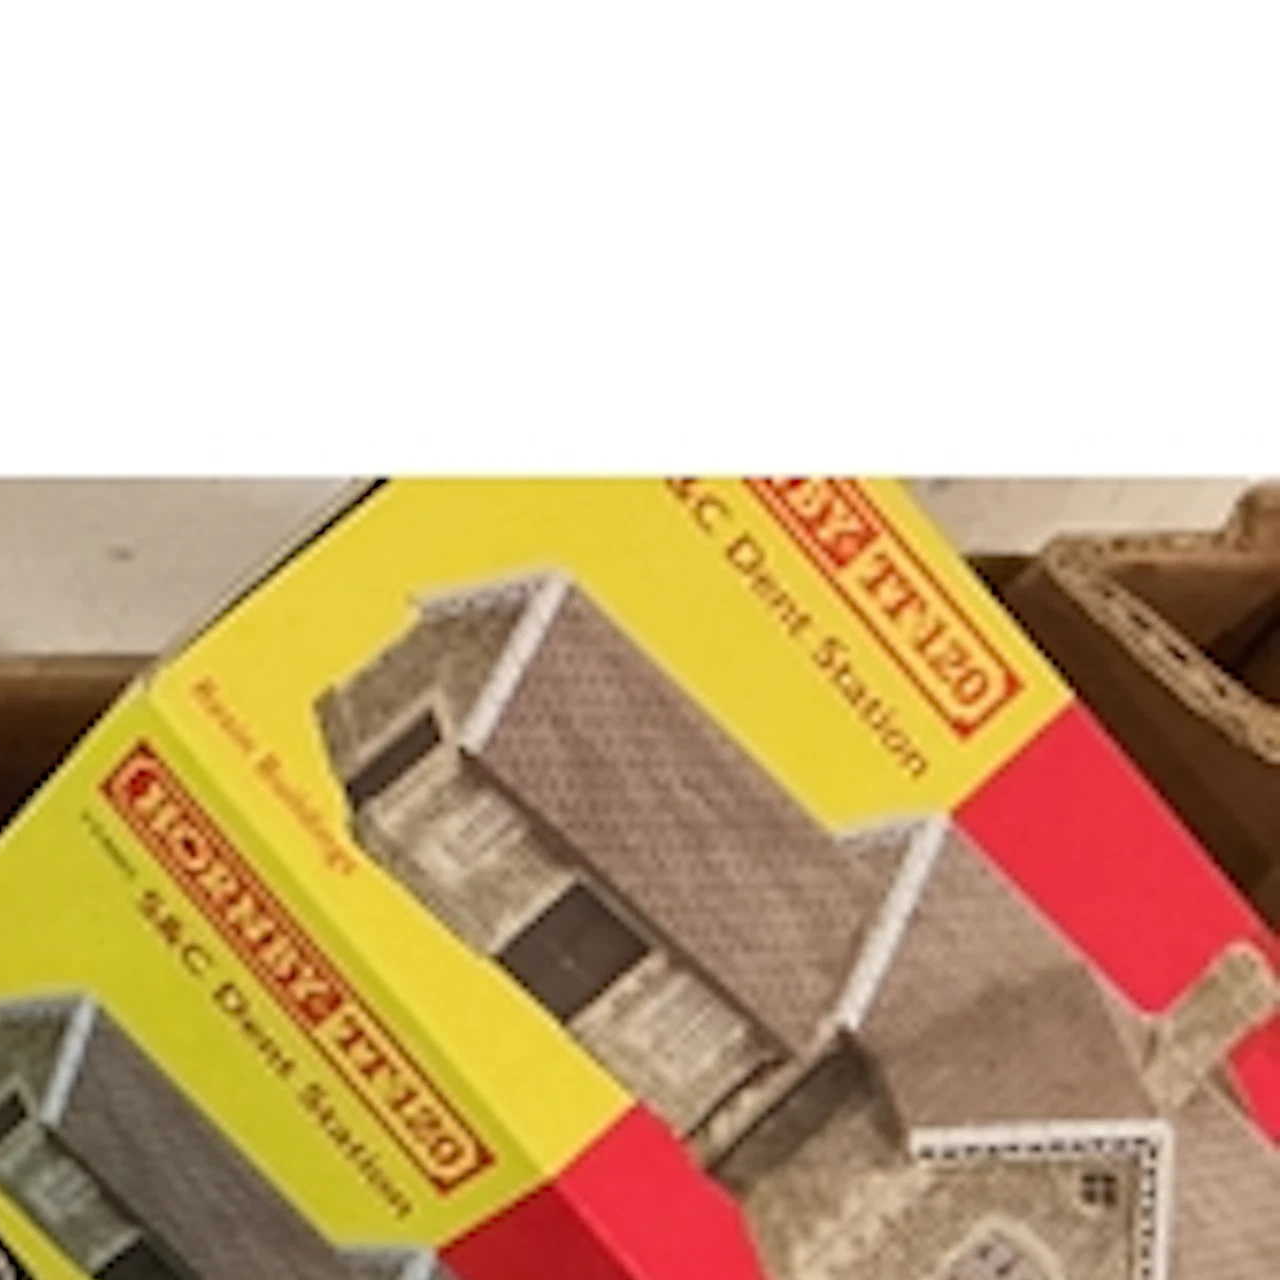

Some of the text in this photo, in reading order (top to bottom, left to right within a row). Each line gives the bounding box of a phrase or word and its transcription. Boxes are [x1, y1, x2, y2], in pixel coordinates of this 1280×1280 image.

[724, 533, 812, 641] Dent
[811, 635, 928, 779] Station
[125, 778, 338, 1014] HORNBY
[142, 889, 412, 1220] S&C Dent Station
